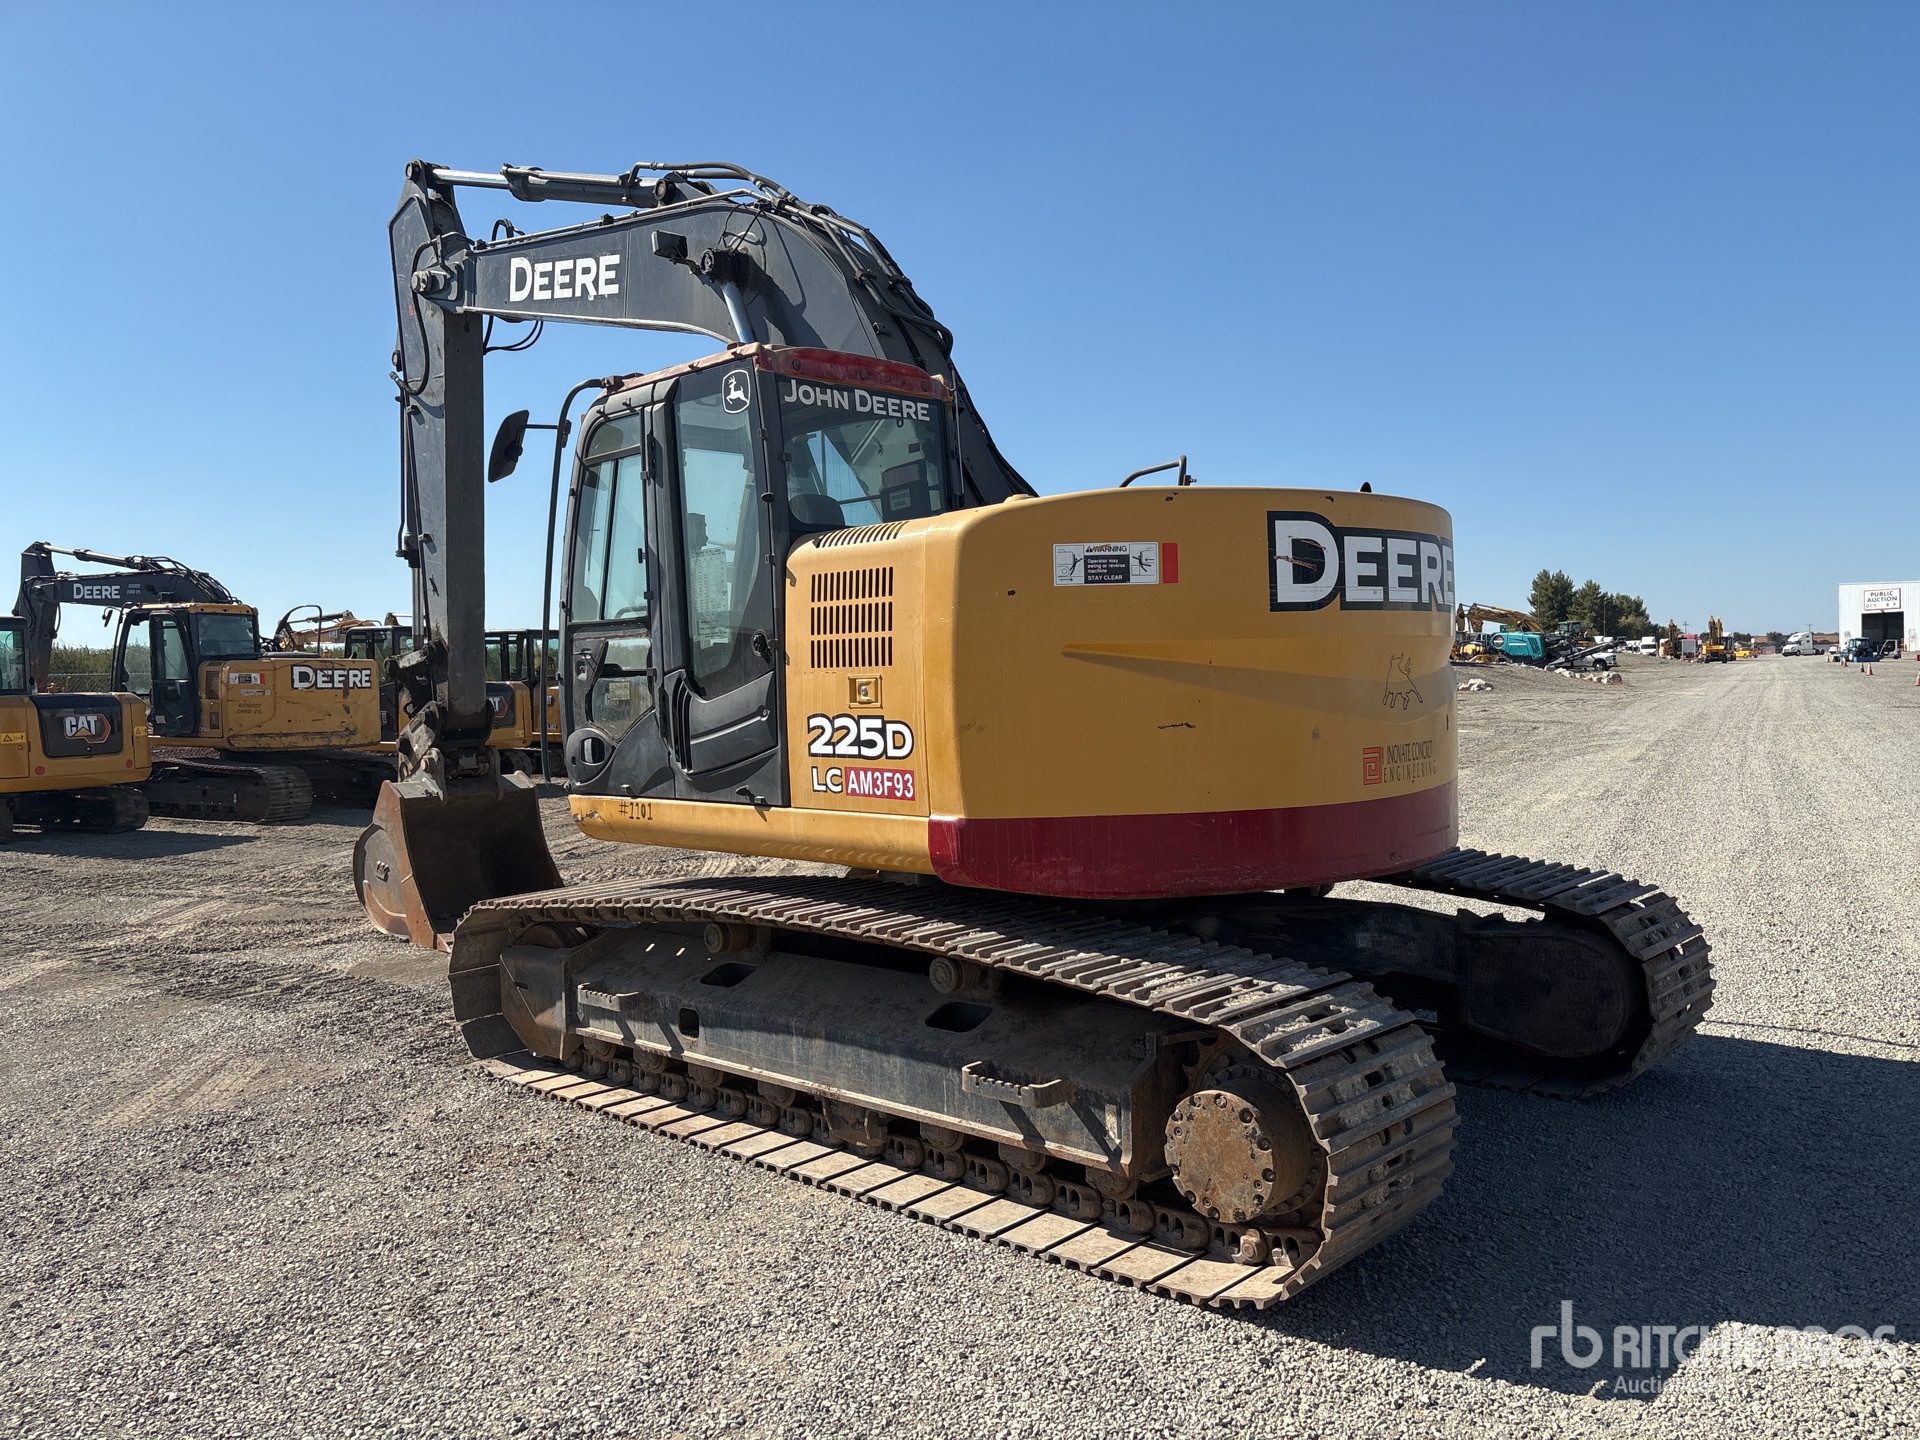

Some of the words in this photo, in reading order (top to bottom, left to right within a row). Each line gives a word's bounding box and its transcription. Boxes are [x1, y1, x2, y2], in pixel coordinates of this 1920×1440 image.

[508, 254, 620, 302] DEERE
[784, 379, 850, 410] JOHN
[854, 389, 931, 422] DEERE
[1274, 519, 1455, 606] DEERE
[73, 583, 121, 599] DEERE
[292, 666, 371, 689] DEERE
[65, 715, 98, 737] CAT
[808, 713, 914, 760] 225D
[811, 767, 844, 793] LC
[847, 771, 914, 799] AM3F93
[1383, 760, 1437, 783] ENGINEERING
[618, 801, 654, 820] #1101
